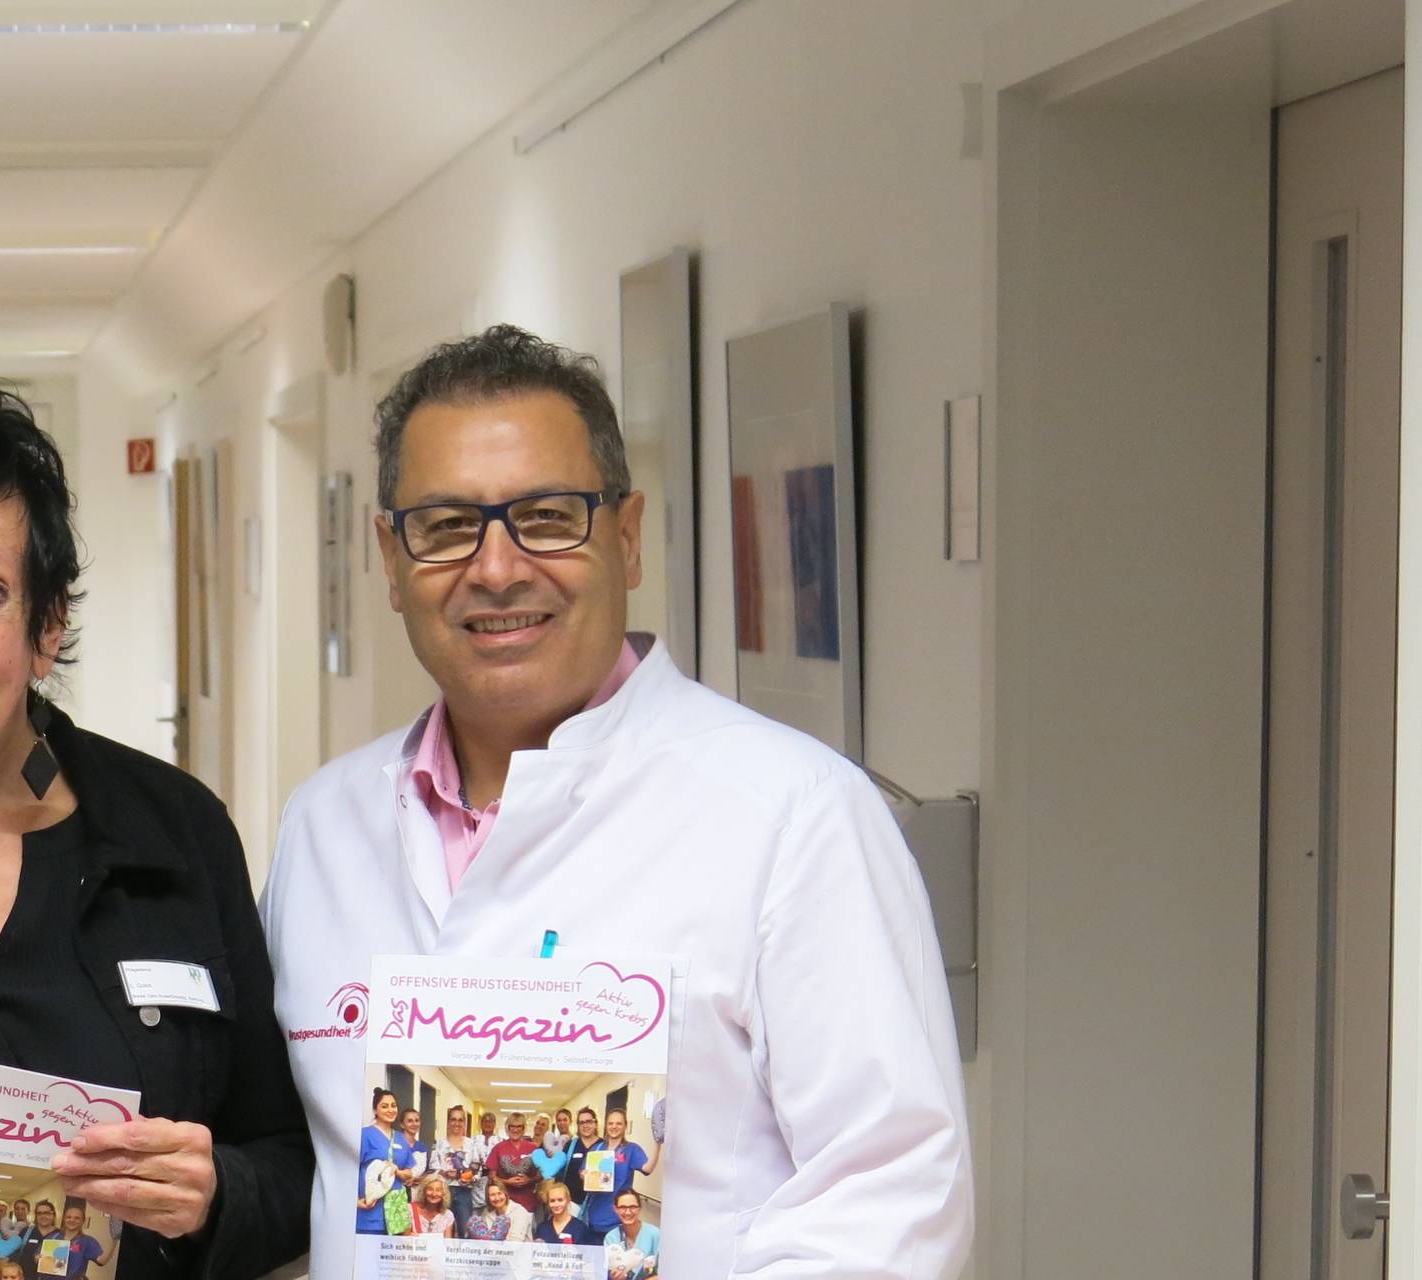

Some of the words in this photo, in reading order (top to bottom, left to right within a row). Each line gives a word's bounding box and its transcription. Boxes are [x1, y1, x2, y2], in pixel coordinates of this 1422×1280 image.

[390, 975, 458, 989] OFFENSIVE
[461, 978, 582, 992] BRUSTGESUNDHEIT
[596, 988, 633, 1007] Aktiv
[381, 997, 409, 1038] Das
[576, 999, 611, 1016] gegen
[615, 1007, 649, 1027] Krebs
[407, 998, 612, 1060] Magazin
[41, 1109, 76, 1127] gegen
[62, 1104, 99, 1124] Aktiv
